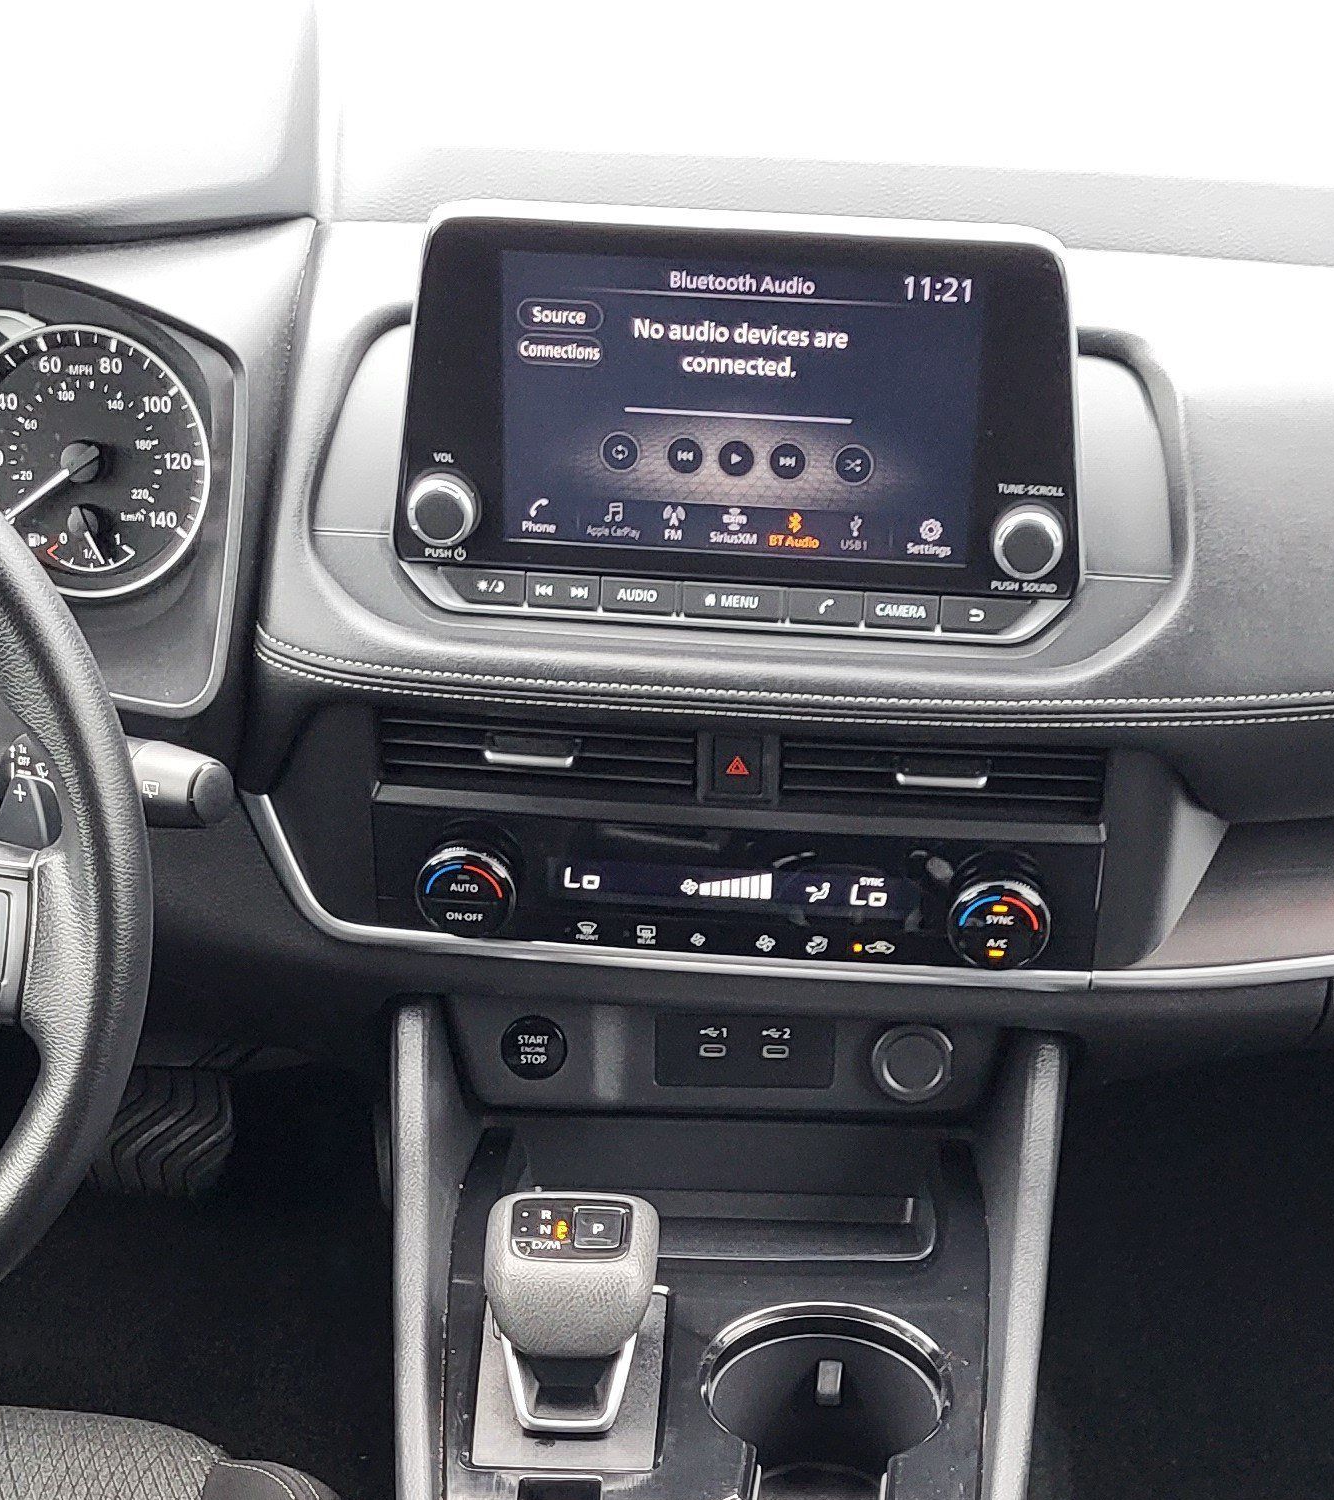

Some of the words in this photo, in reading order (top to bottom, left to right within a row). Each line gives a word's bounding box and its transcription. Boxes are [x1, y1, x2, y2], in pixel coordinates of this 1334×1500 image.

[669, 270, 756, 293] Bluetooth
[760, 275, 816, 296] Audio
[902, 275, 973, 304] 11:21
[531, 306, 586, 326] Source
[632, 316, 665, 340] No
[668, 320, 730, 345] audio
[733, 322, 810, 348] devices
[814, 330, 849, 350] are
[519, 340, 601, 362] Connections
[38, 355, 62, 374] 60
[68, 364, 93, 377] MPH
[99, 357, 123, 375] 80
[681, 353, 797, 379] connected.
[56, 389, 75, 401] 100
[106, 399, 124, 411] 140
[141, 395, 172, 414] 100
[24, 418, 38, 431] 60
[164, 451, 192, 470] 120
[433, 451, 454, 464] VOL
[19, 469, 33, 482] 20
[130, 488, 149, 501] 220
[120, 509, 145, 524] km/h
[148, 510, 177, 529] 140
[521, 519, 557, 534] Phone
[586, 524, 611, 538] Apple
[58, 532, 68, 545] 0
[114, 533, 121, 545] 1
[663, 528, 683, 541] FM
[709, 531, 758, 546] SiriusXM
[768, 534, 784, 547] BT
[785, 535, 820, 549] Audio
[424, 546, 453, 559] PUSH
[906, 541, 952, 558] Settings
[990, 580, 1020, 593] PUSH
[1022, 581, 1058, 594] SOUND
[616, 587, 658, 603] AUDIO
[720, 594, 759, 609] MENU
[875, 603, 927, 619] CAMERA
[449, 882, 479, 893] AUTO
[859, 876, 885, 887] SYNC
[985, 915, 1015, 926] SYNC
[575, 933, 599, 941] FRONT
[986, 938, 1008, 949] A/C
[720, 1027, 728, 1038] 1
[782, 1028, 791, 1039] 2
[517, 1034, 549, 1045] START
[520, 1054, 548, 1065] STOP
[540, 1209, 552, 1219] R
[539, 1224, 552, 1235] N
[592, 1223, 605, 1235] P
[531, 1240, 562, 1250] D/M
